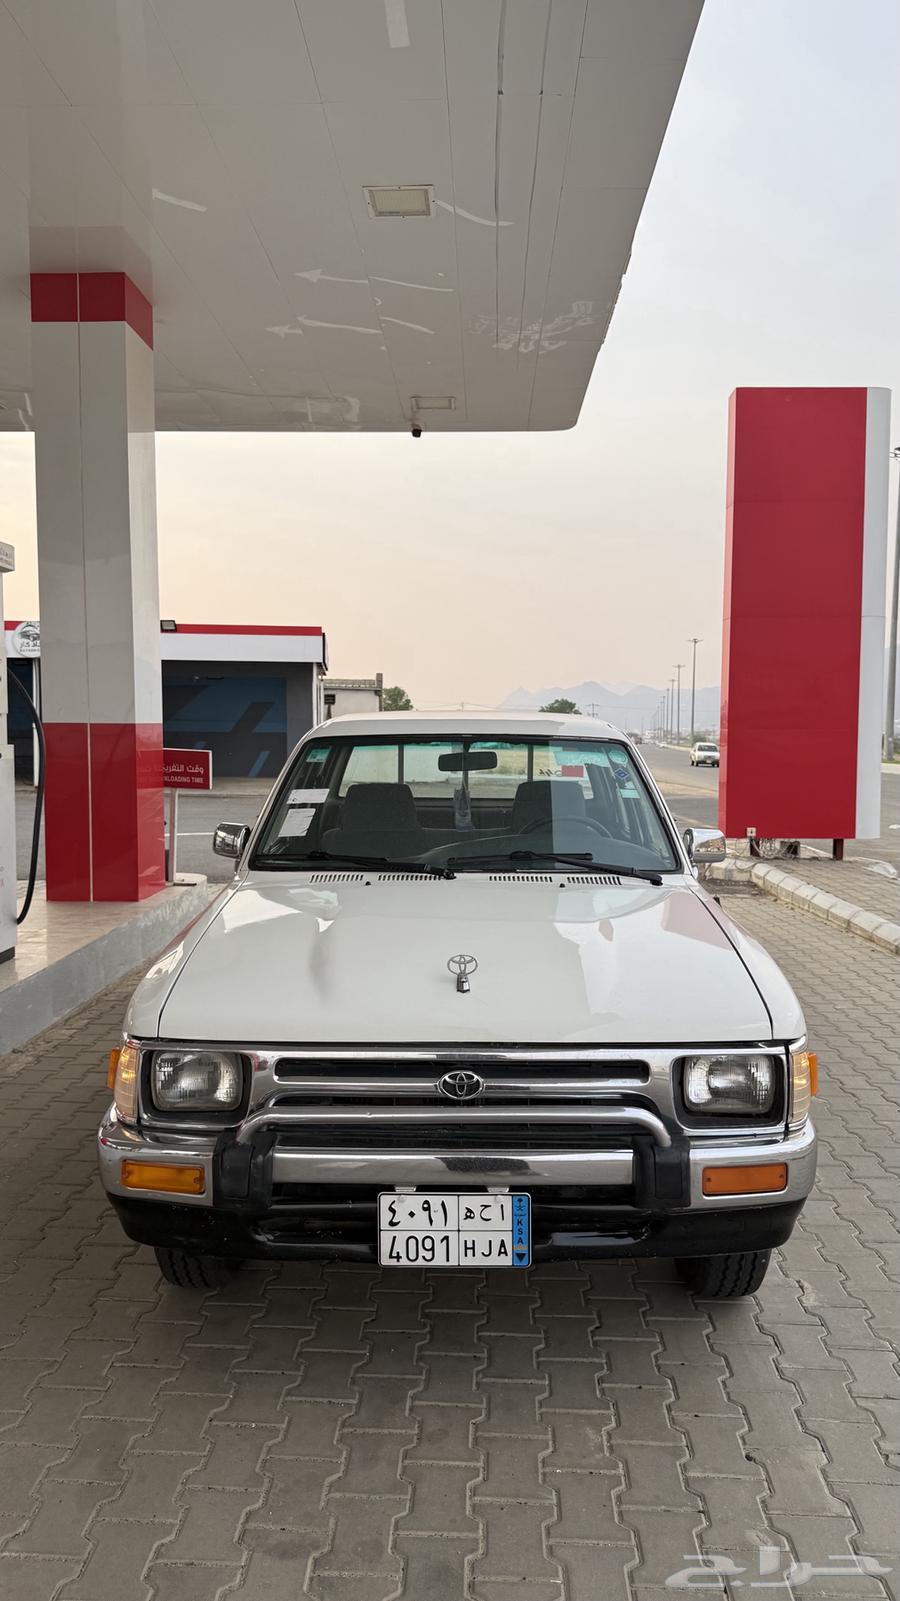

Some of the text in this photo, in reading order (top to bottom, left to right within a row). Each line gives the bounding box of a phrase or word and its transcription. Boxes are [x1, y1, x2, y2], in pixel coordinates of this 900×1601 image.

[163, 762, 204, 775] وقت التفري
[164, 775, 204, 784] NLOADING TIME
[388, 1199, 448, 1227] ٤٠٩١
[388, 1235, 508, 1263] 4091 HJA
